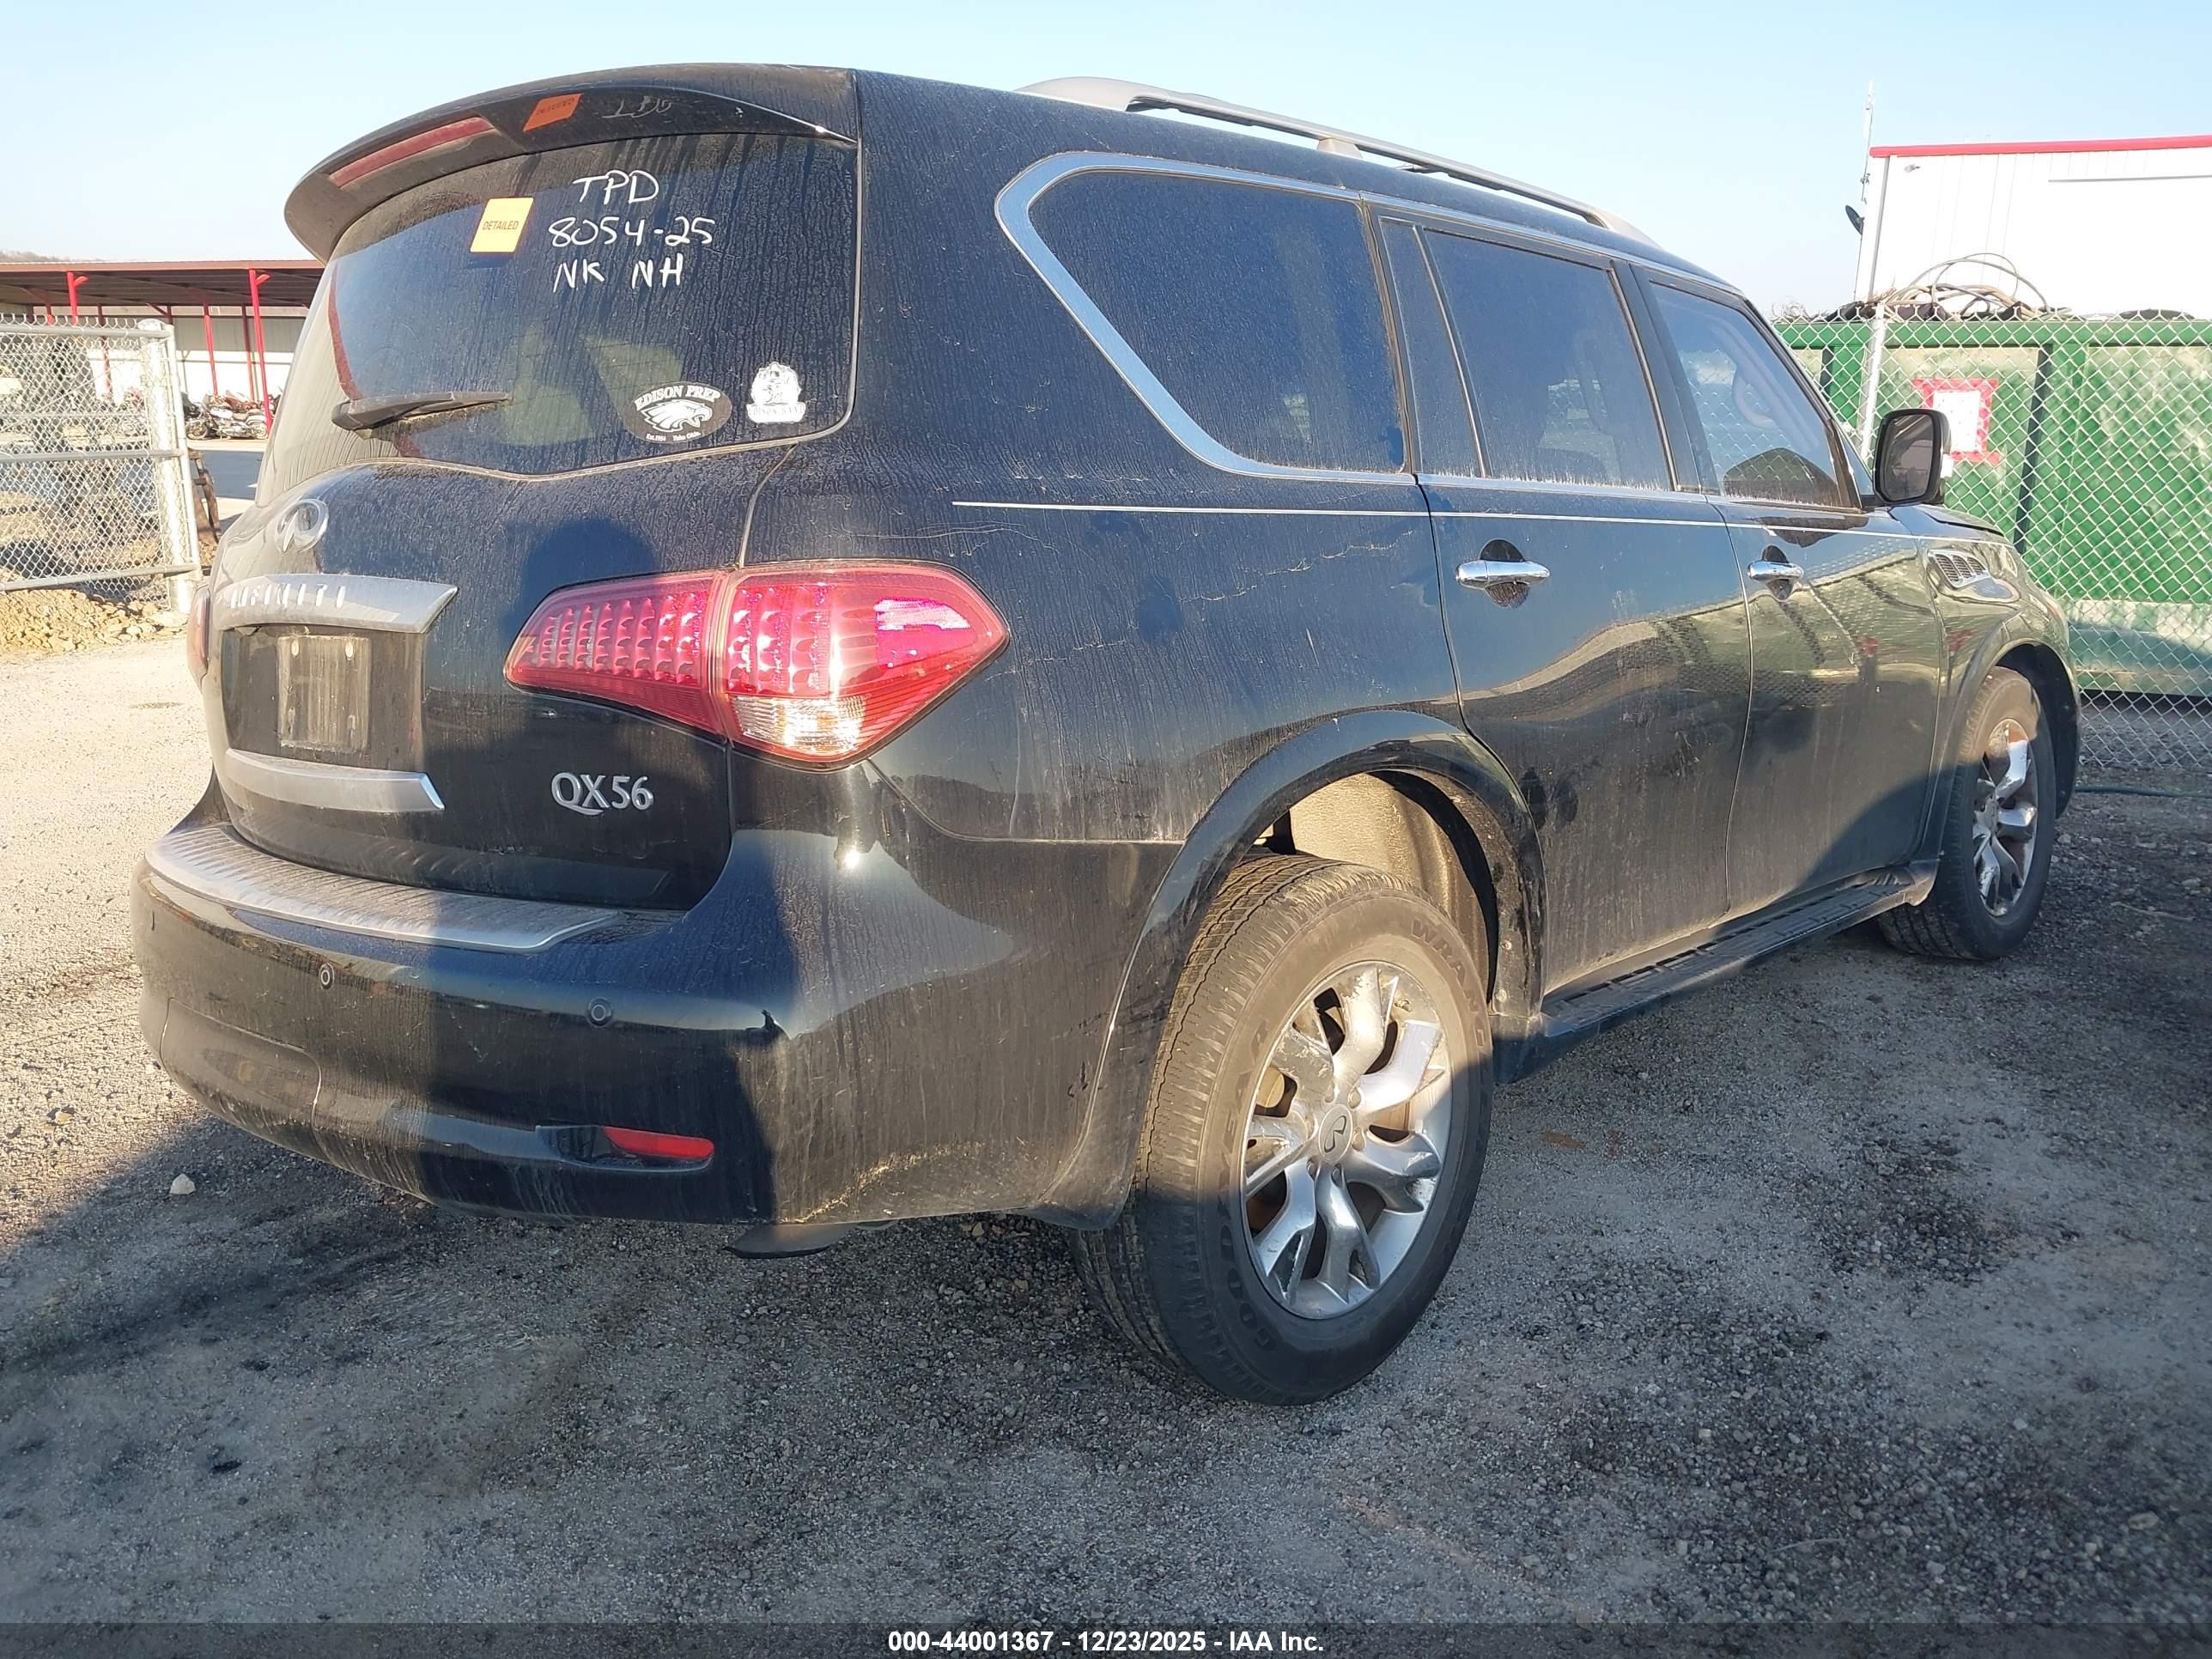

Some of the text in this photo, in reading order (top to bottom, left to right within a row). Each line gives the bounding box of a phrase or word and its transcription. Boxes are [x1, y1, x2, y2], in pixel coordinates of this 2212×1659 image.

[573, 169, 659, 204] TPD
[482, 220, 520, 231] DETAILED
[548, 216, 715, 247] 8054-25
[553, 253, 684, 294] NK NH
[634, 385, 721, 411] EDISON PREP
[550, 771, 654, 816] QX56
